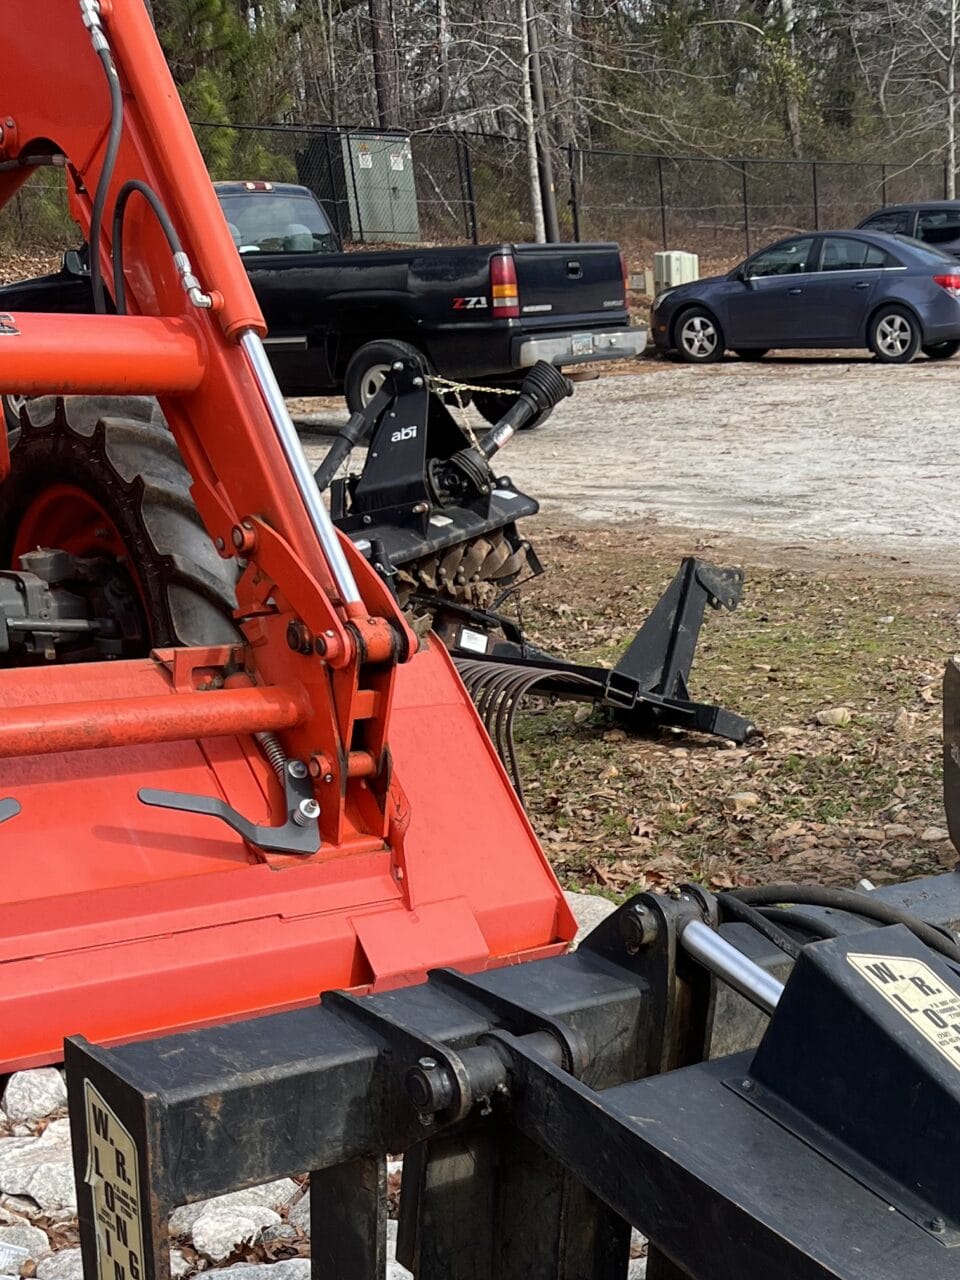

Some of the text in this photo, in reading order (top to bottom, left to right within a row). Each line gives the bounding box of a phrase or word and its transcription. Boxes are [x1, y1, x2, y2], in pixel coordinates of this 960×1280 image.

[452, 297, 488, 309] Z71
[391, 426, 417, 442] abi
[865, 962, 942, 997] W. R.
[91, 1103, 114, 1146] W.
[114, 1147, 131, 1187] R.
